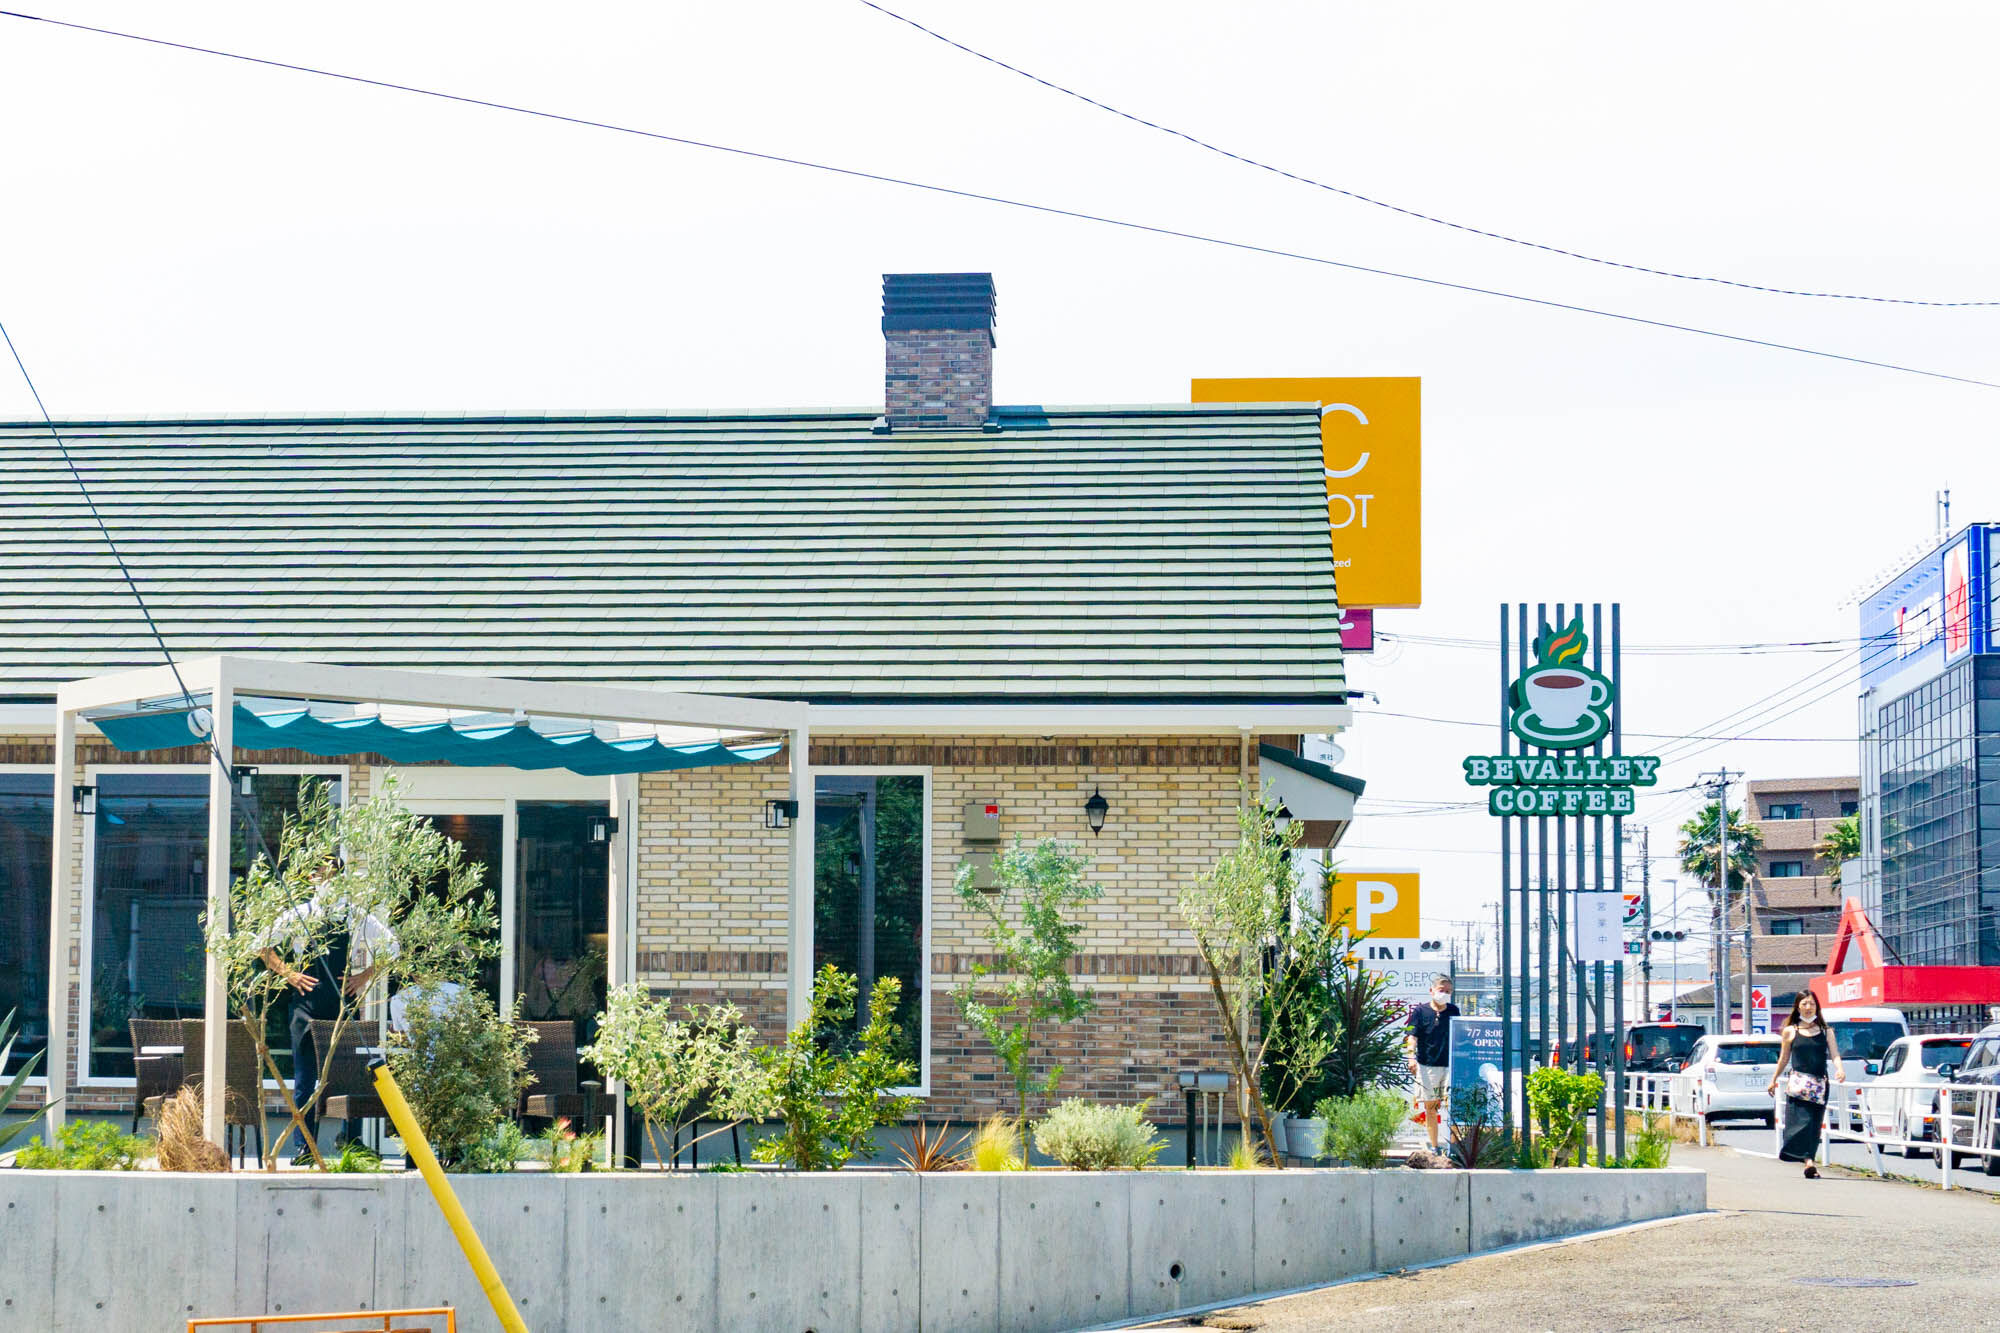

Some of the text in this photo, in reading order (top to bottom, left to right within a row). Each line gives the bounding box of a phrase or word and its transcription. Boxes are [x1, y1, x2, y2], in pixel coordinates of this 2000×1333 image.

[1469, 759, 1657, 780] BEVALLEY
[1495, 790, 1631, 811] COFFEE
[1356, 880, 1399, 931] P
